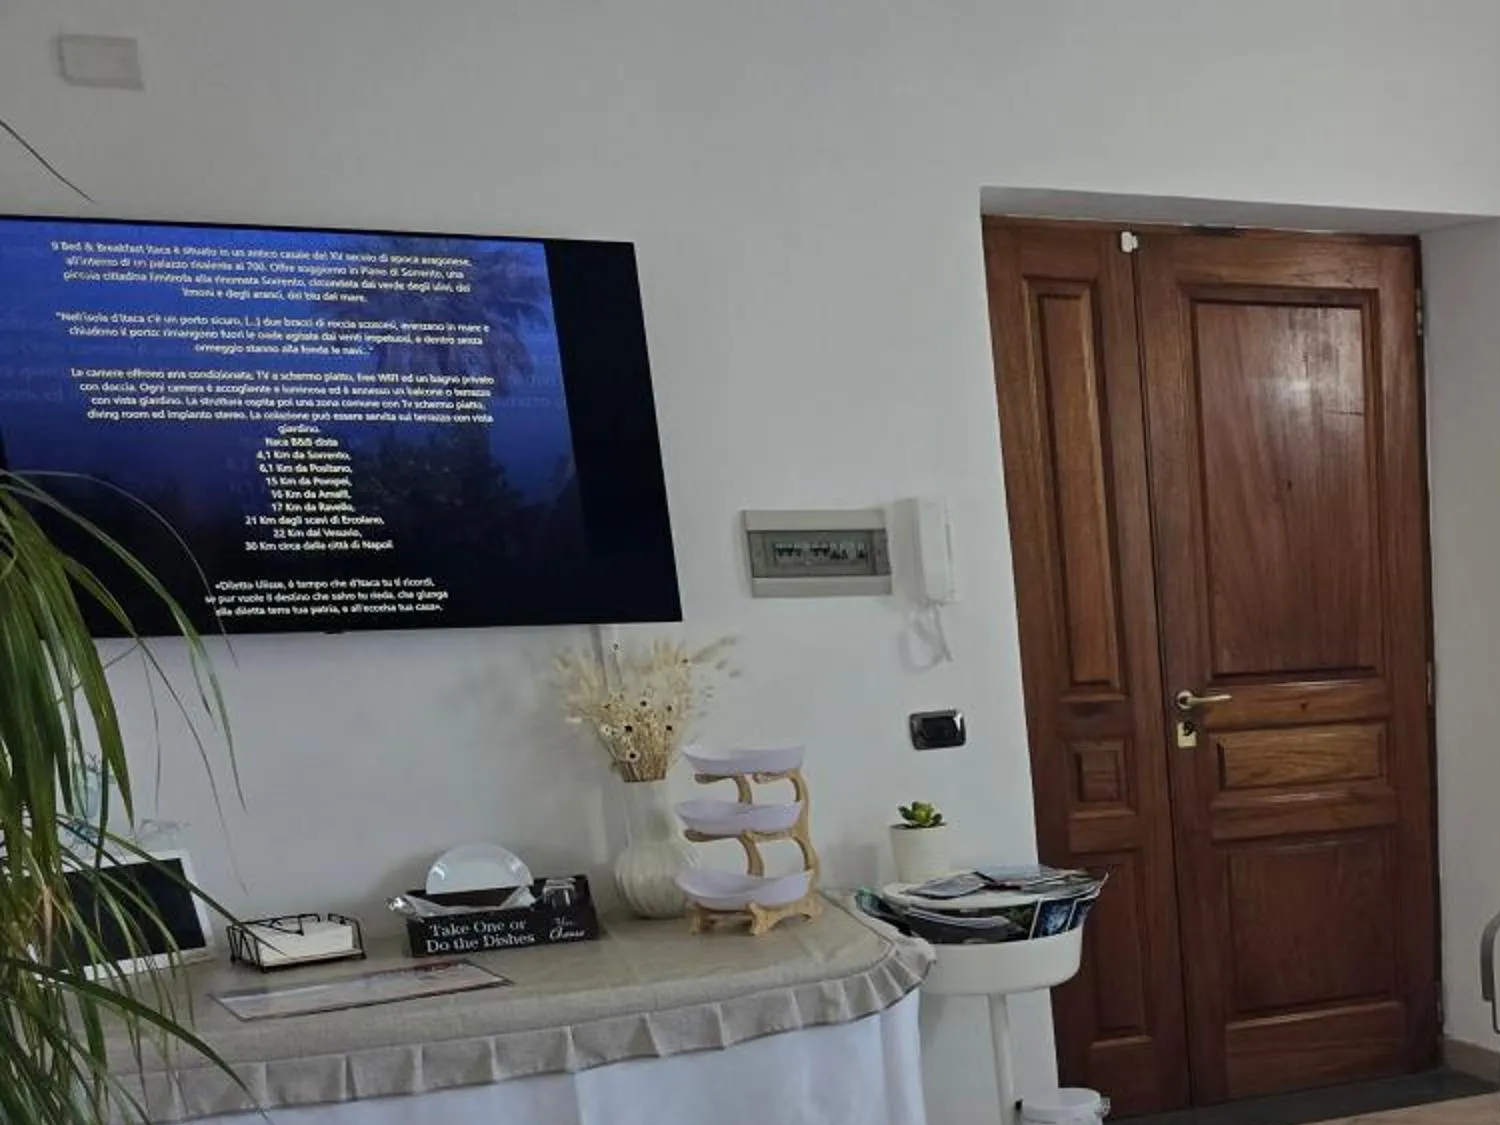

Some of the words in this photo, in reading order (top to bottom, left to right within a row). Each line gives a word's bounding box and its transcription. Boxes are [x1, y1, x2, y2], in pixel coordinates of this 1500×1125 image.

[430, 924, 470, 937] Take
[473, 920, 505, 933] One
[509, 919, 527, 930] or
[427, 940, 449, 953] Do
[453, 937, 479, 949] the
[483, 934, 535, 948] Dishes
